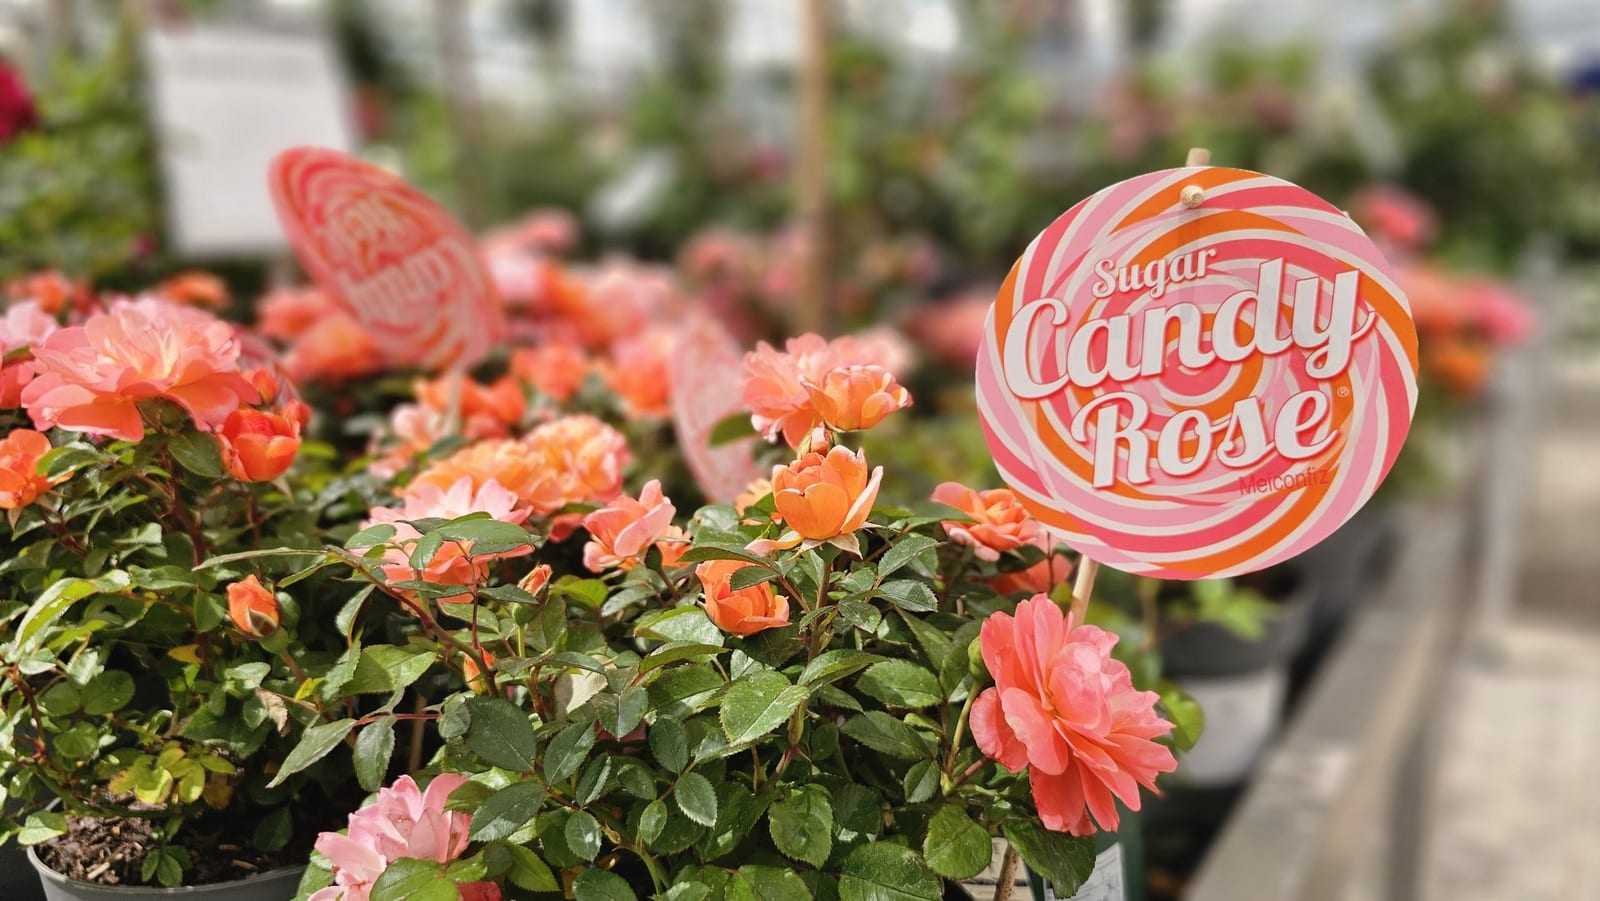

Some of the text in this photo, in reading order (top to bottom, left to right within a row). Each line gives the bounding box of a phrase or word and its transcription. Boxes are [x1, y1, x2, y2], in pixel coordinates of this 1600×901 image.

[1092, 247, 1216, 298] Sugar
[1003, 257, 1376, 399] Candy
[1070, 391, 1338, 488] Rose
